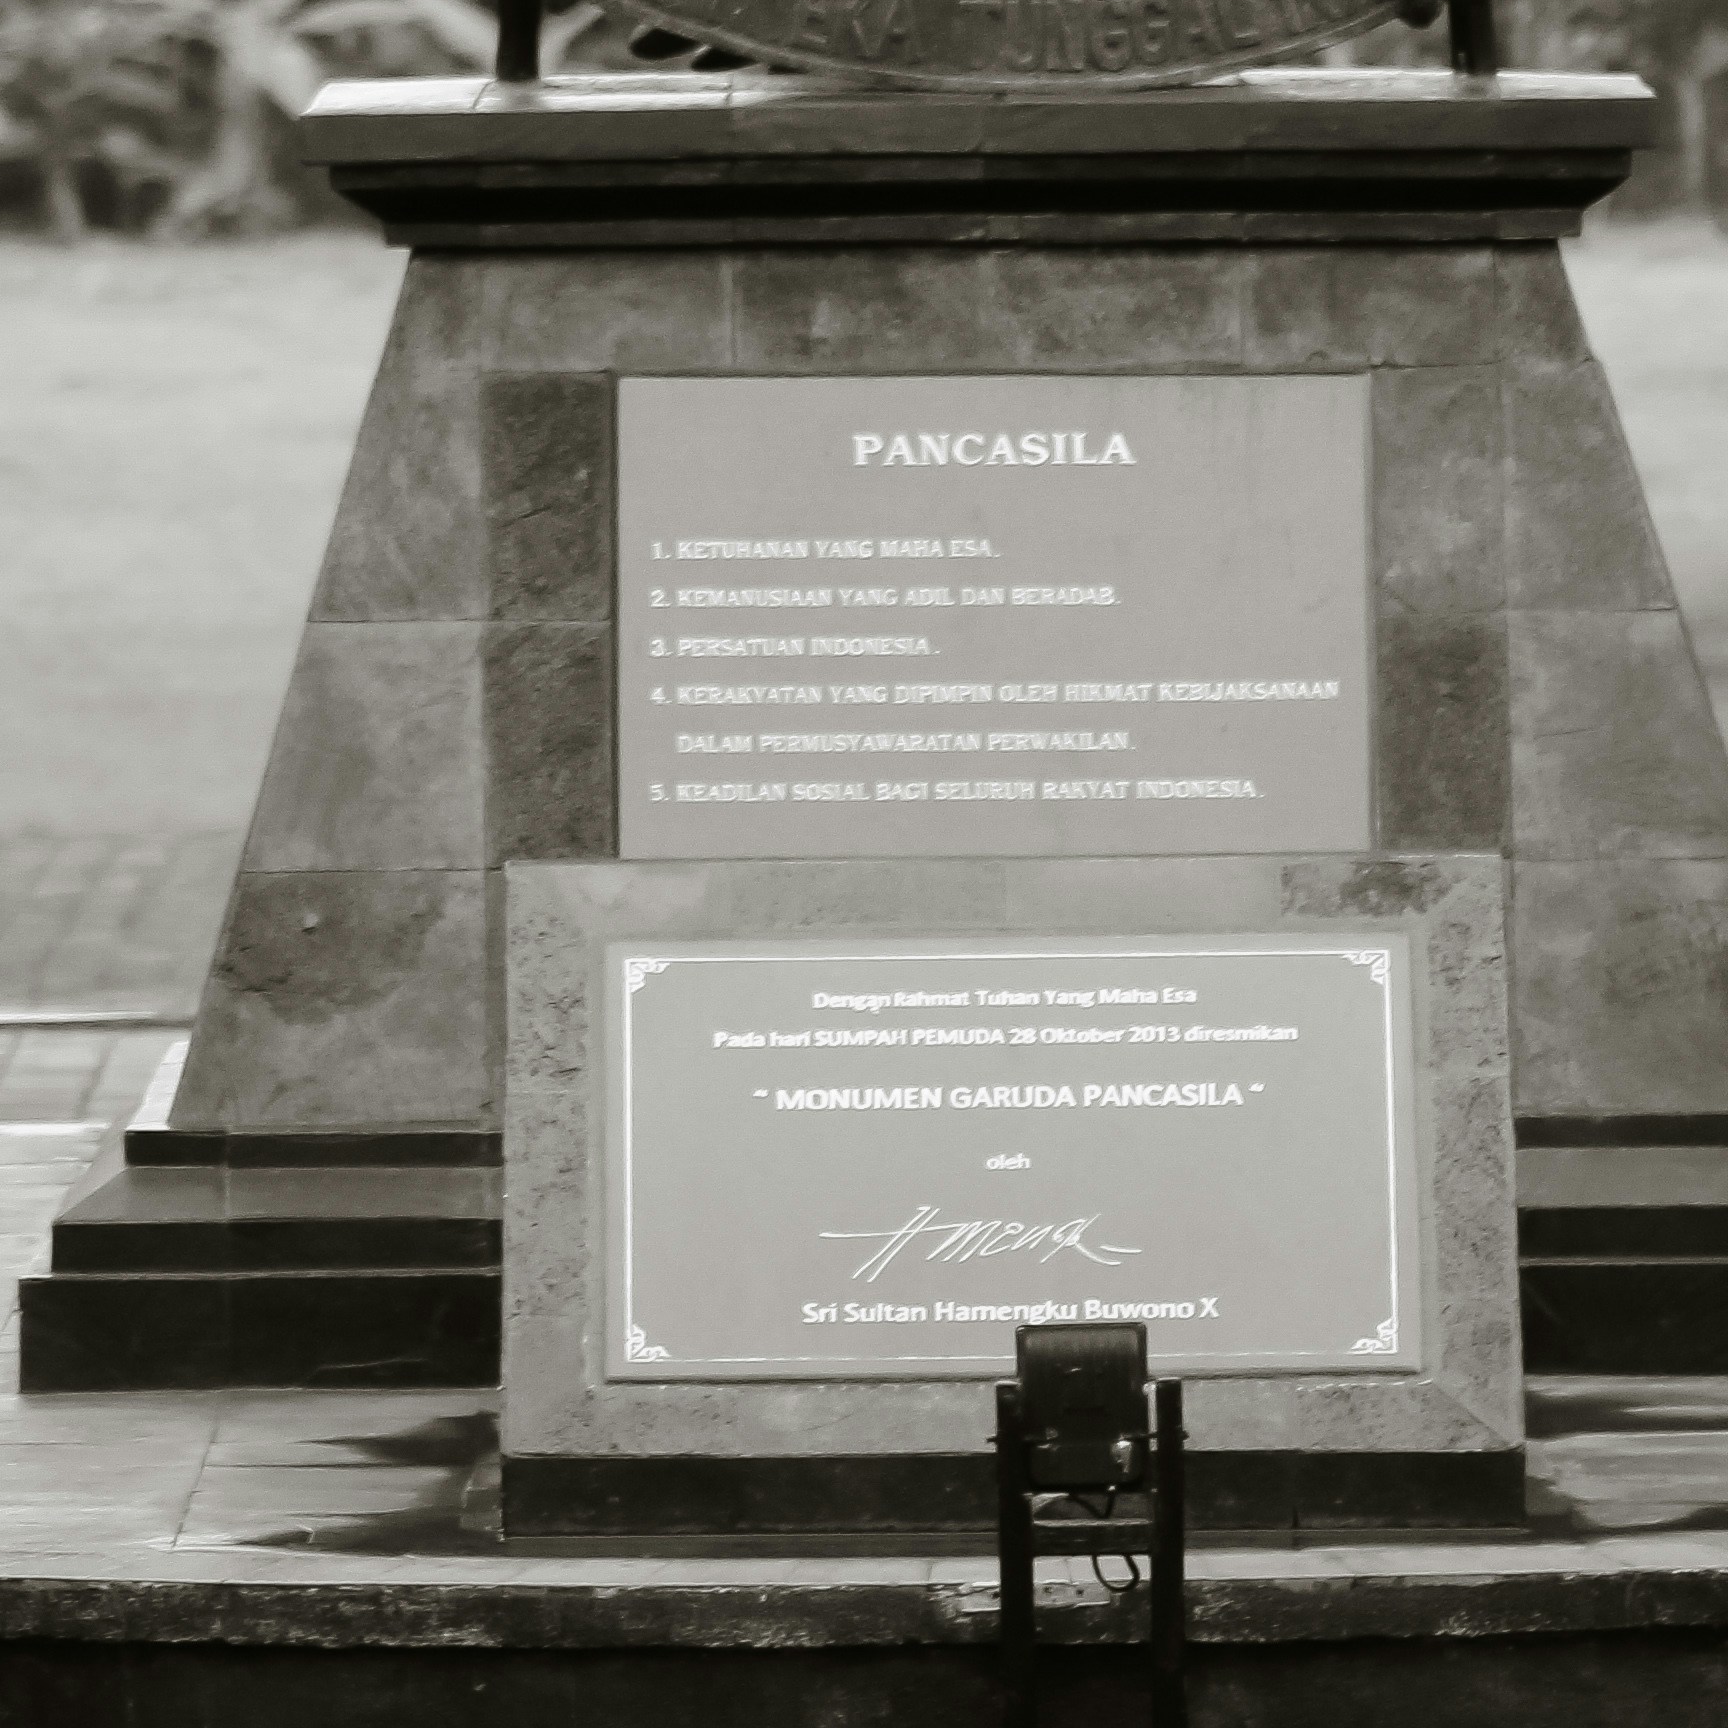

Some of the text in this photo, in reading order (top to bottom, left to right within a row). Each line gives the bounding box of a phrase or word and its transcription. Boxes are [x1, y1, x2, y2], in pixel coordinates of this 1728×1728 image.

[852, 430, 1137, 467] PANCASILA
[651, 538, 1002, 560] 1. KETUHANAN YANG MAHA ESA.
[650, 585, 1121, 608] 2. KEMANUSIAAN YANG ADIL DAN BERADAB.
[650, 635, 941, 658] 3. PERSATUAN INDONESIA.
[677, 683, 823, 705] KERAKYATAN
[828, 683, 889, 704] YANG
[892, 682, 995, 704] DIPIMPIN
[999, 682, 1059, 703] OLEH
[1063, 682, 1153, 702] HIKMAT
[1156, 680, 1340, 702] KEBIJAKSANAAN
[677, 730, 1137, 753] DALAM PERMUSYAWARATAN PERWAKILAN.
[676, 782, 787, 802] KEADILAN
[791, 781, 870, 802] SOSIAL
[874, 781, 929, 801] BAGI
[933, 780, 1036, 801] SELURUH
[1041, 779, 1131, 800] RAKYAT
[1135, 778, 1265, 799] INDONESIA.
[812, 987, 1198, 1014] Dengan Rahmat Tuhan Yang Maha Esa
[712, 1024, 1299, 1048] Pada hari SUMPAH PEMUDA 28 Oktober 2013 diresmikan
[775, 1086, 944, 1110] MONUMEN
[949, 1084, 1077, 1109] GARUDA
[1083, 1082, 1244, 1108] PANCASILA
[985, 1152, 1032, 1170] oleh
[802, 1296, 1220, 1325] Sri Sultan Hamengku Buwono X
